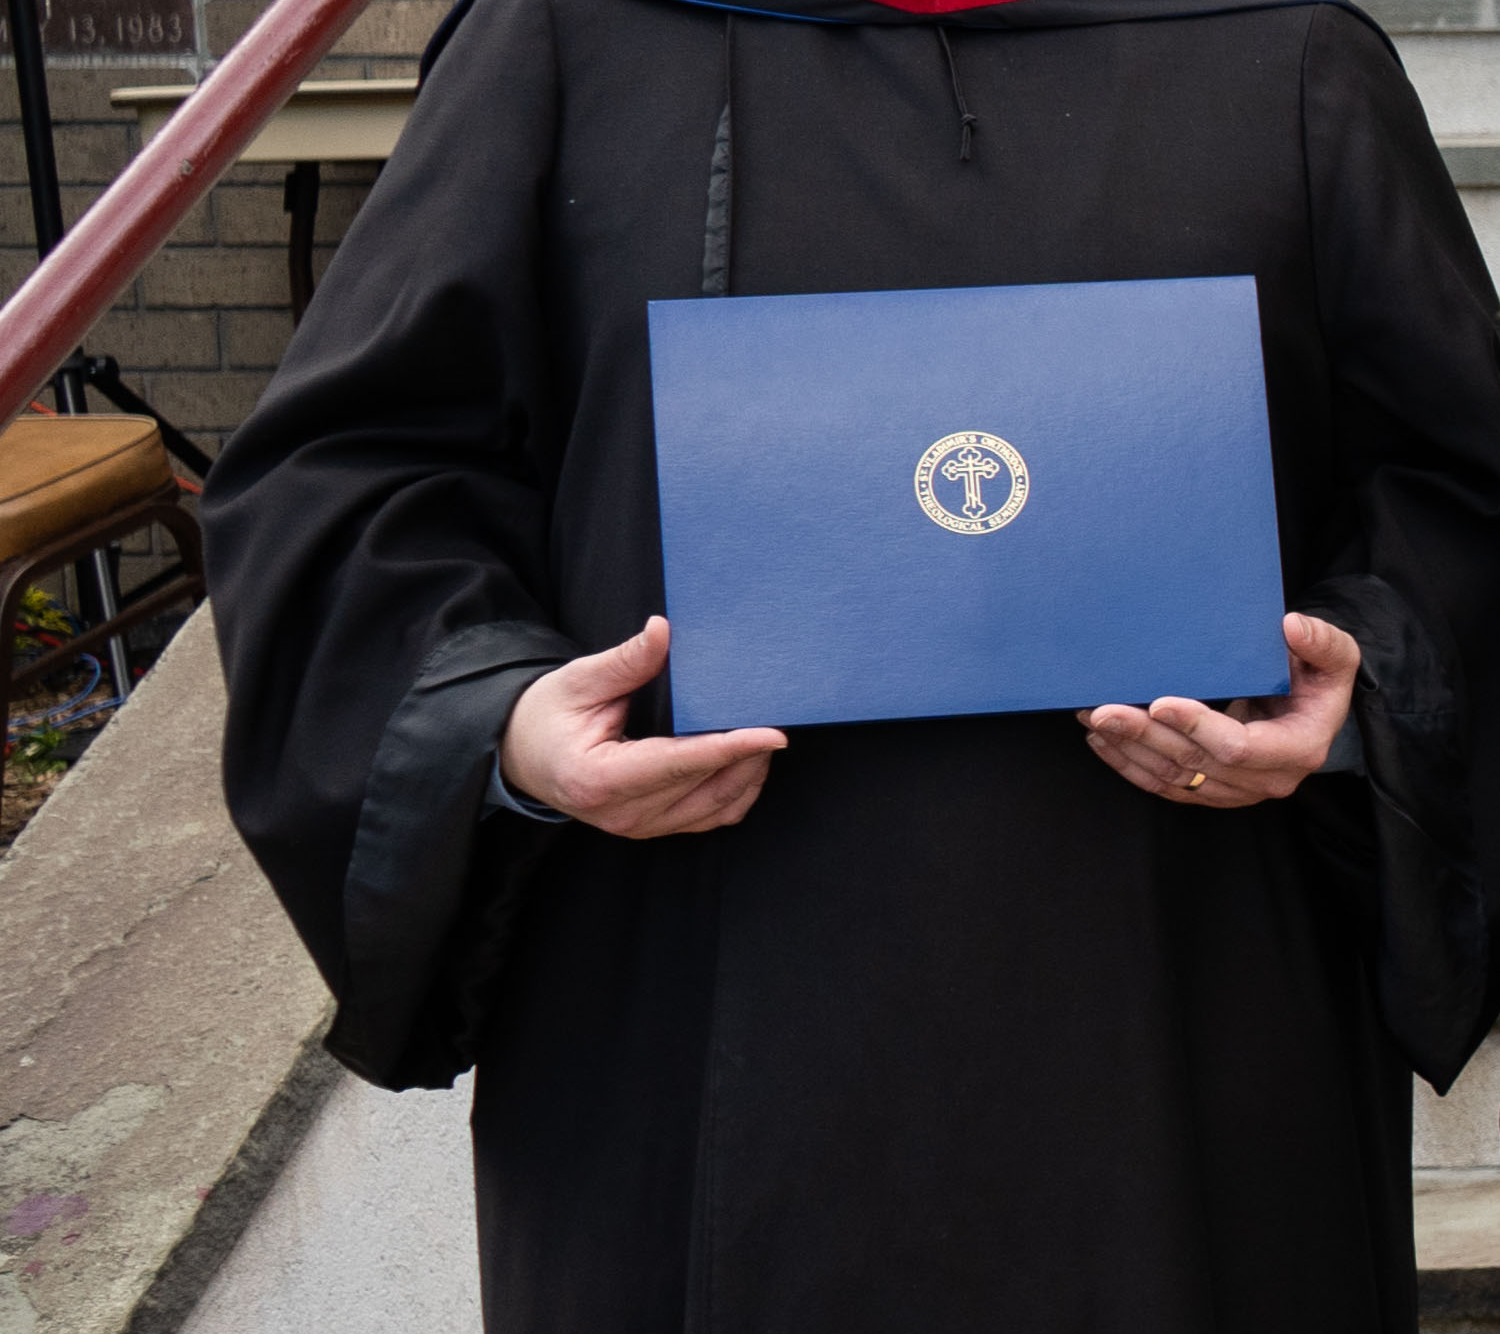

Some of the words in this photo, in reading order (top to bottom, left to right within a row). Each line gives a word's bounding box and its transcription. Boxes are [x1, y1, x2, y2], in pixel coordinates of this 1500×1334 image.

[117, 13, 182, 43] 1983
[920, 489, 986, 530] THEOLOGICAL
[988, 483, 1025, 527] SEMINARY
